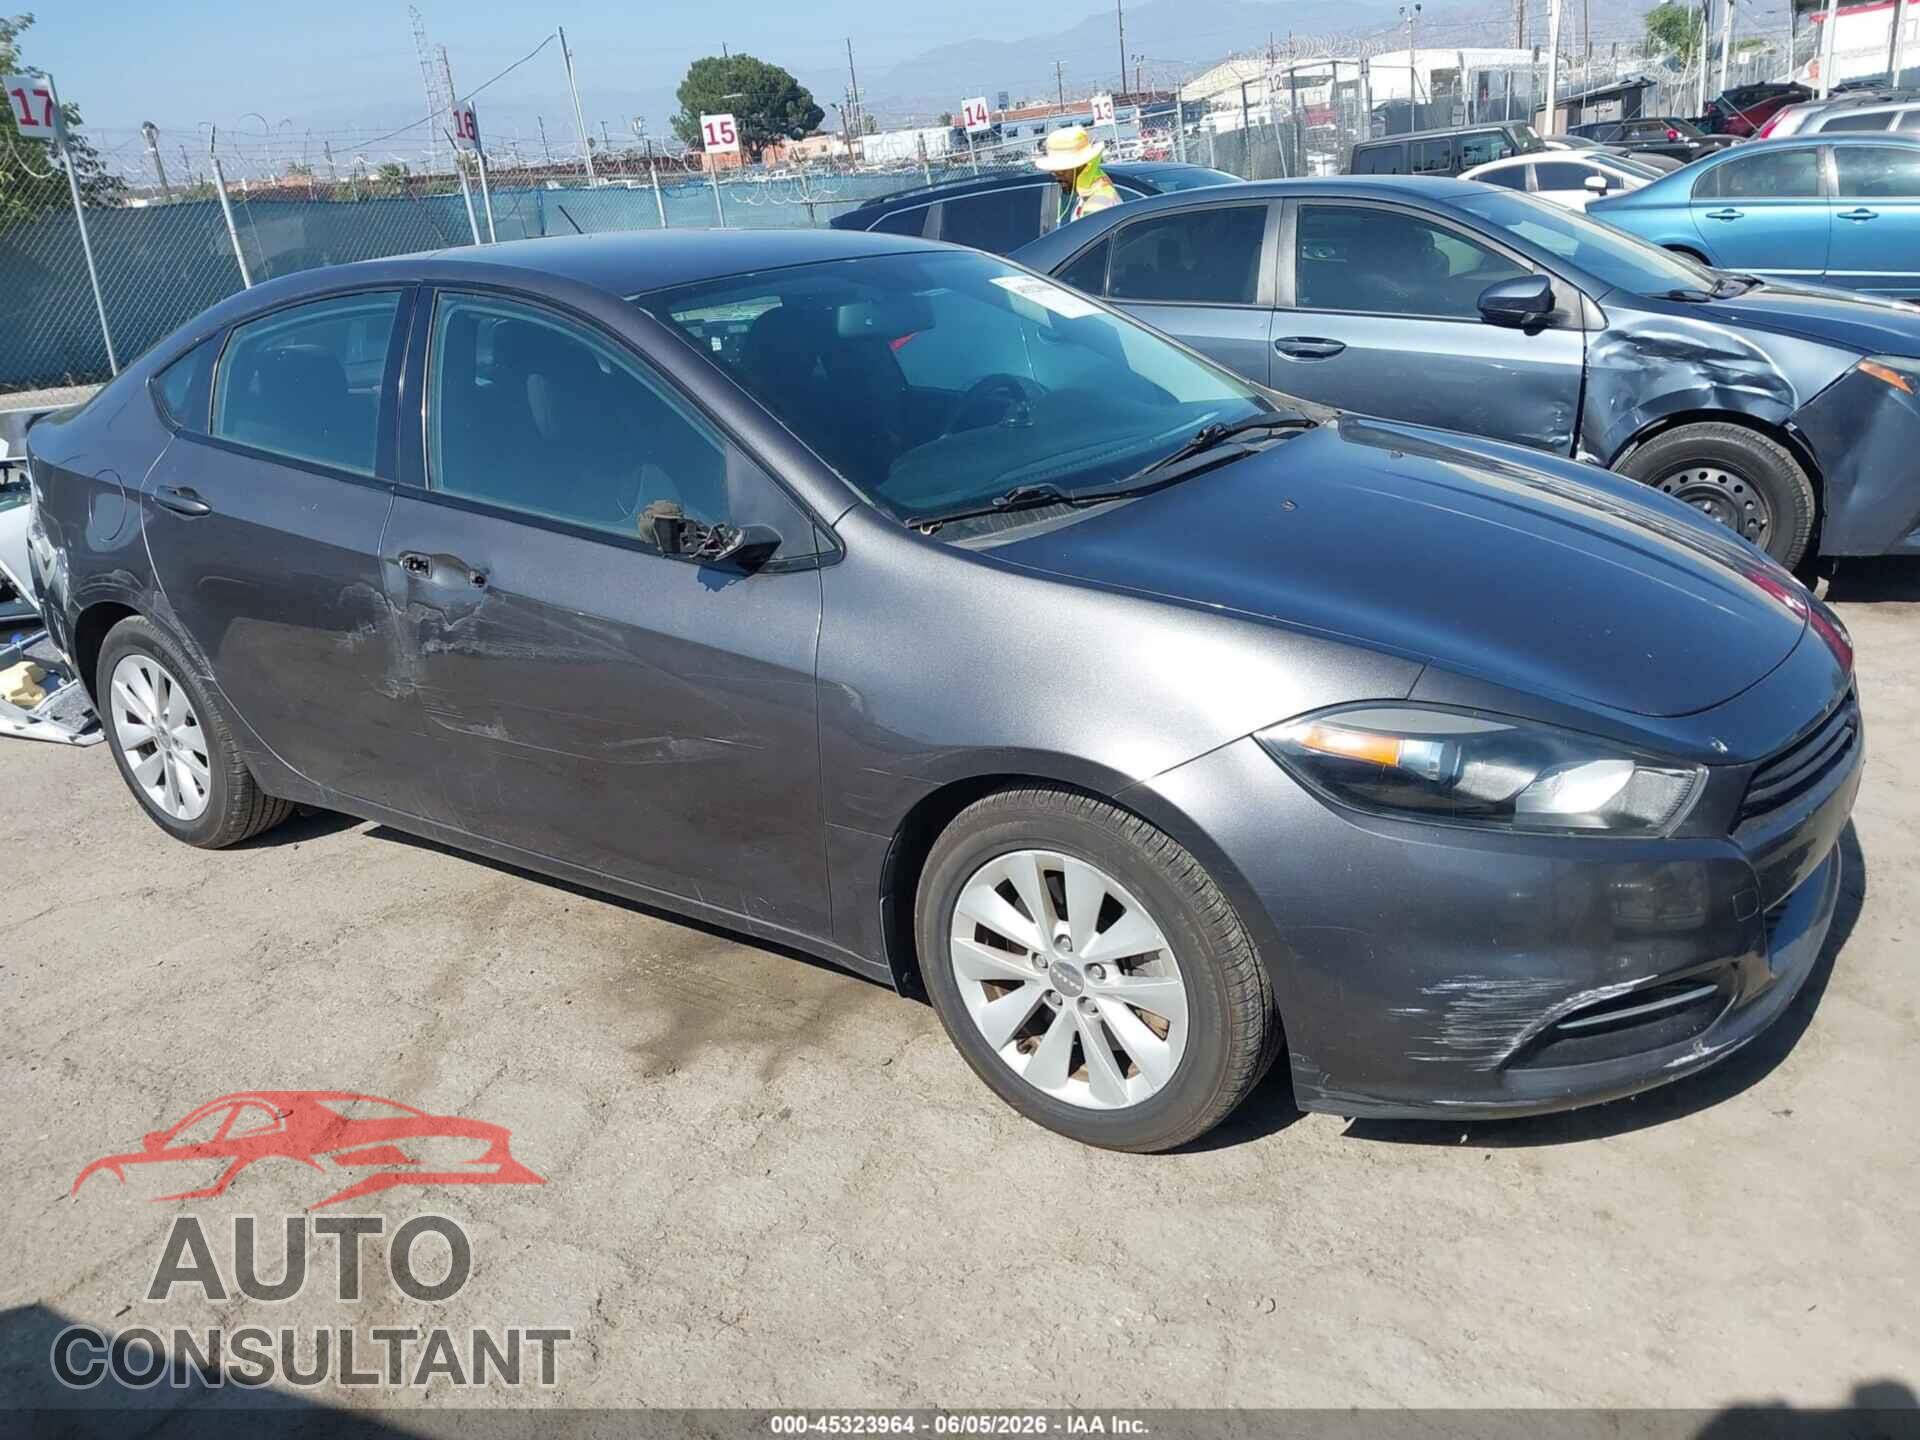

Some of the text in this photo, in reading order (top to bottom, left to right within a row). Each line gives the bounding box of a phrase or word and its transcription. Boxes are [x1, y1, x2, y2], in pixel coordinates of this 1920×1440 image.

[1268, 73, 1282, 92] 12
[10, 87, 53, 127] 17
[964, 103, 988, 127] 14
[1094, 101, 1113, 121] 13
[453, 110, 476, 140] 16
[704, 121, 735, 146] 15
